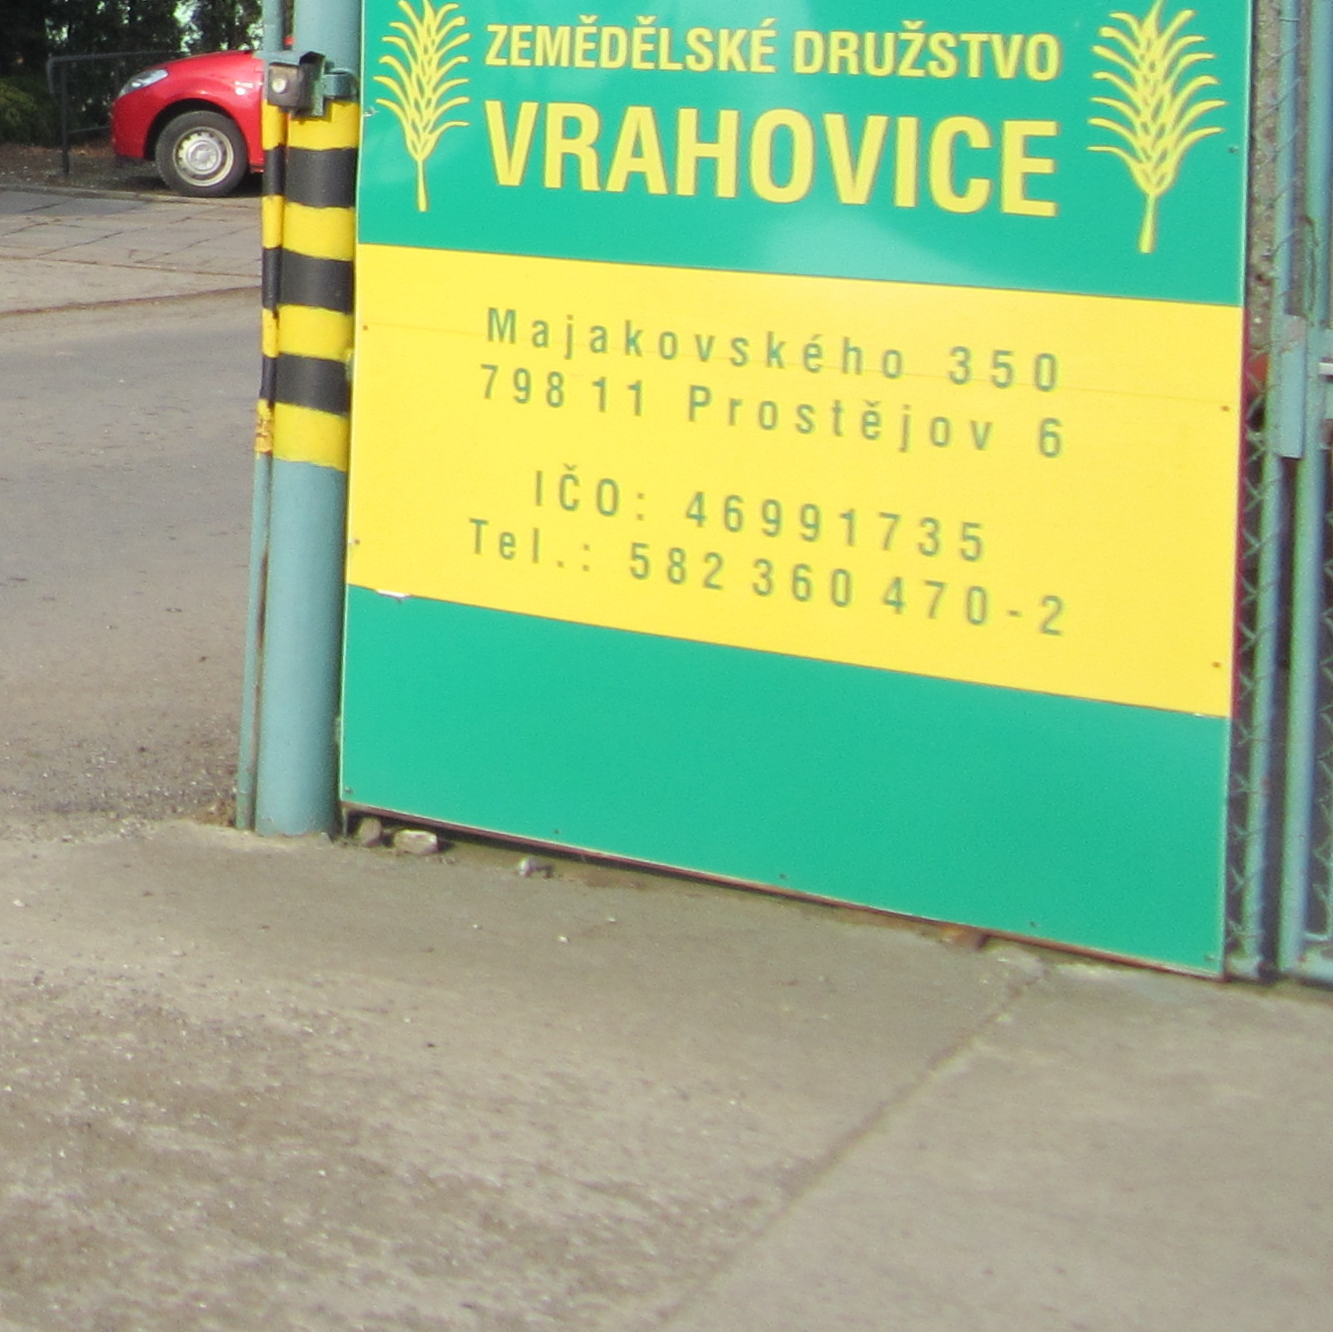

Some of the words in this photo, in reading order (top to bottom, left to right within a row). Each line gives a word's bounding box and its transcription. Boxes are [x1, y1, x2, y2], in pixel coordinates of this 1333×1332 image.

[484, 14, 780, 75] ZEMĚDĚLSKÉ
[792, 20, 1062, 82] DRUŽSTVO
[484, 99, 1060, 218] VRAHOVICE
[486, 306, 903, 381] Majakovského
[948, 345, 1058, 394] 350
[687, 383, 993, 454] Prostějov
[1037, 416, 1063, 460] 6
[534, 462, 646, 522] IČO:
[685, 490, 985, 564] 46991735
[467, 517, 592, 574] Tel.:
[629, 541, 724, 592] 582
[752, 557, 853, 610] 360
